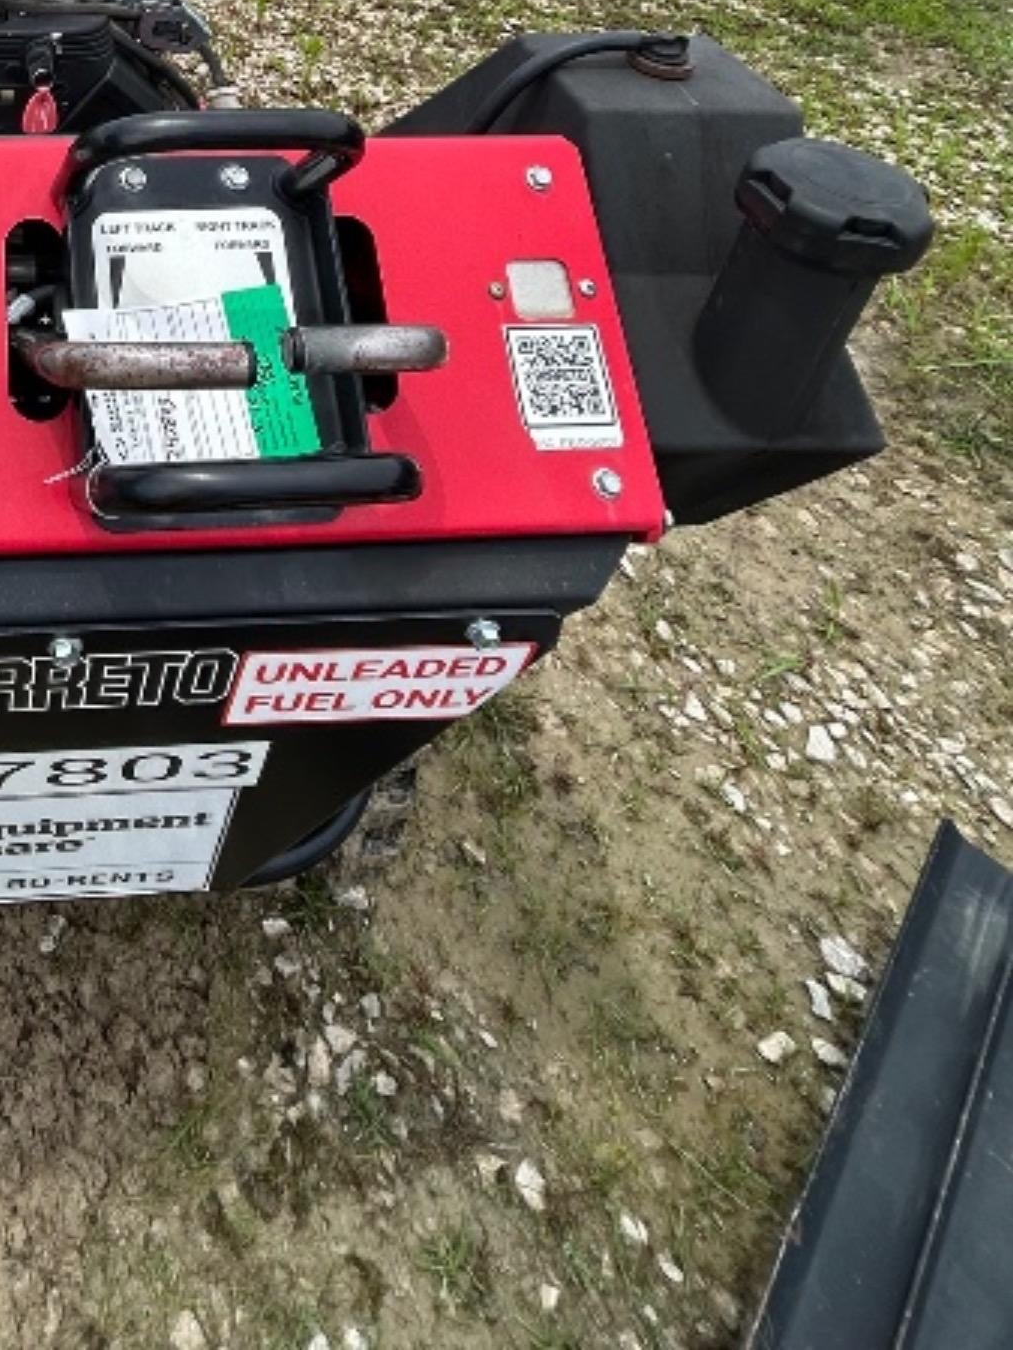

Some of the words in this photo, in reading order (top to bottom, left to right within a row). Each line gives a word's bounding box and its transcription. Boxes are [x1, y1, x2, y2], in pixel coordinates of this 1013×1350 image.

[255, 656, 507, 684] UNLEADED
[244, 691, 355, 714] FUEL
[371, 687, 495, 710] ONLY
